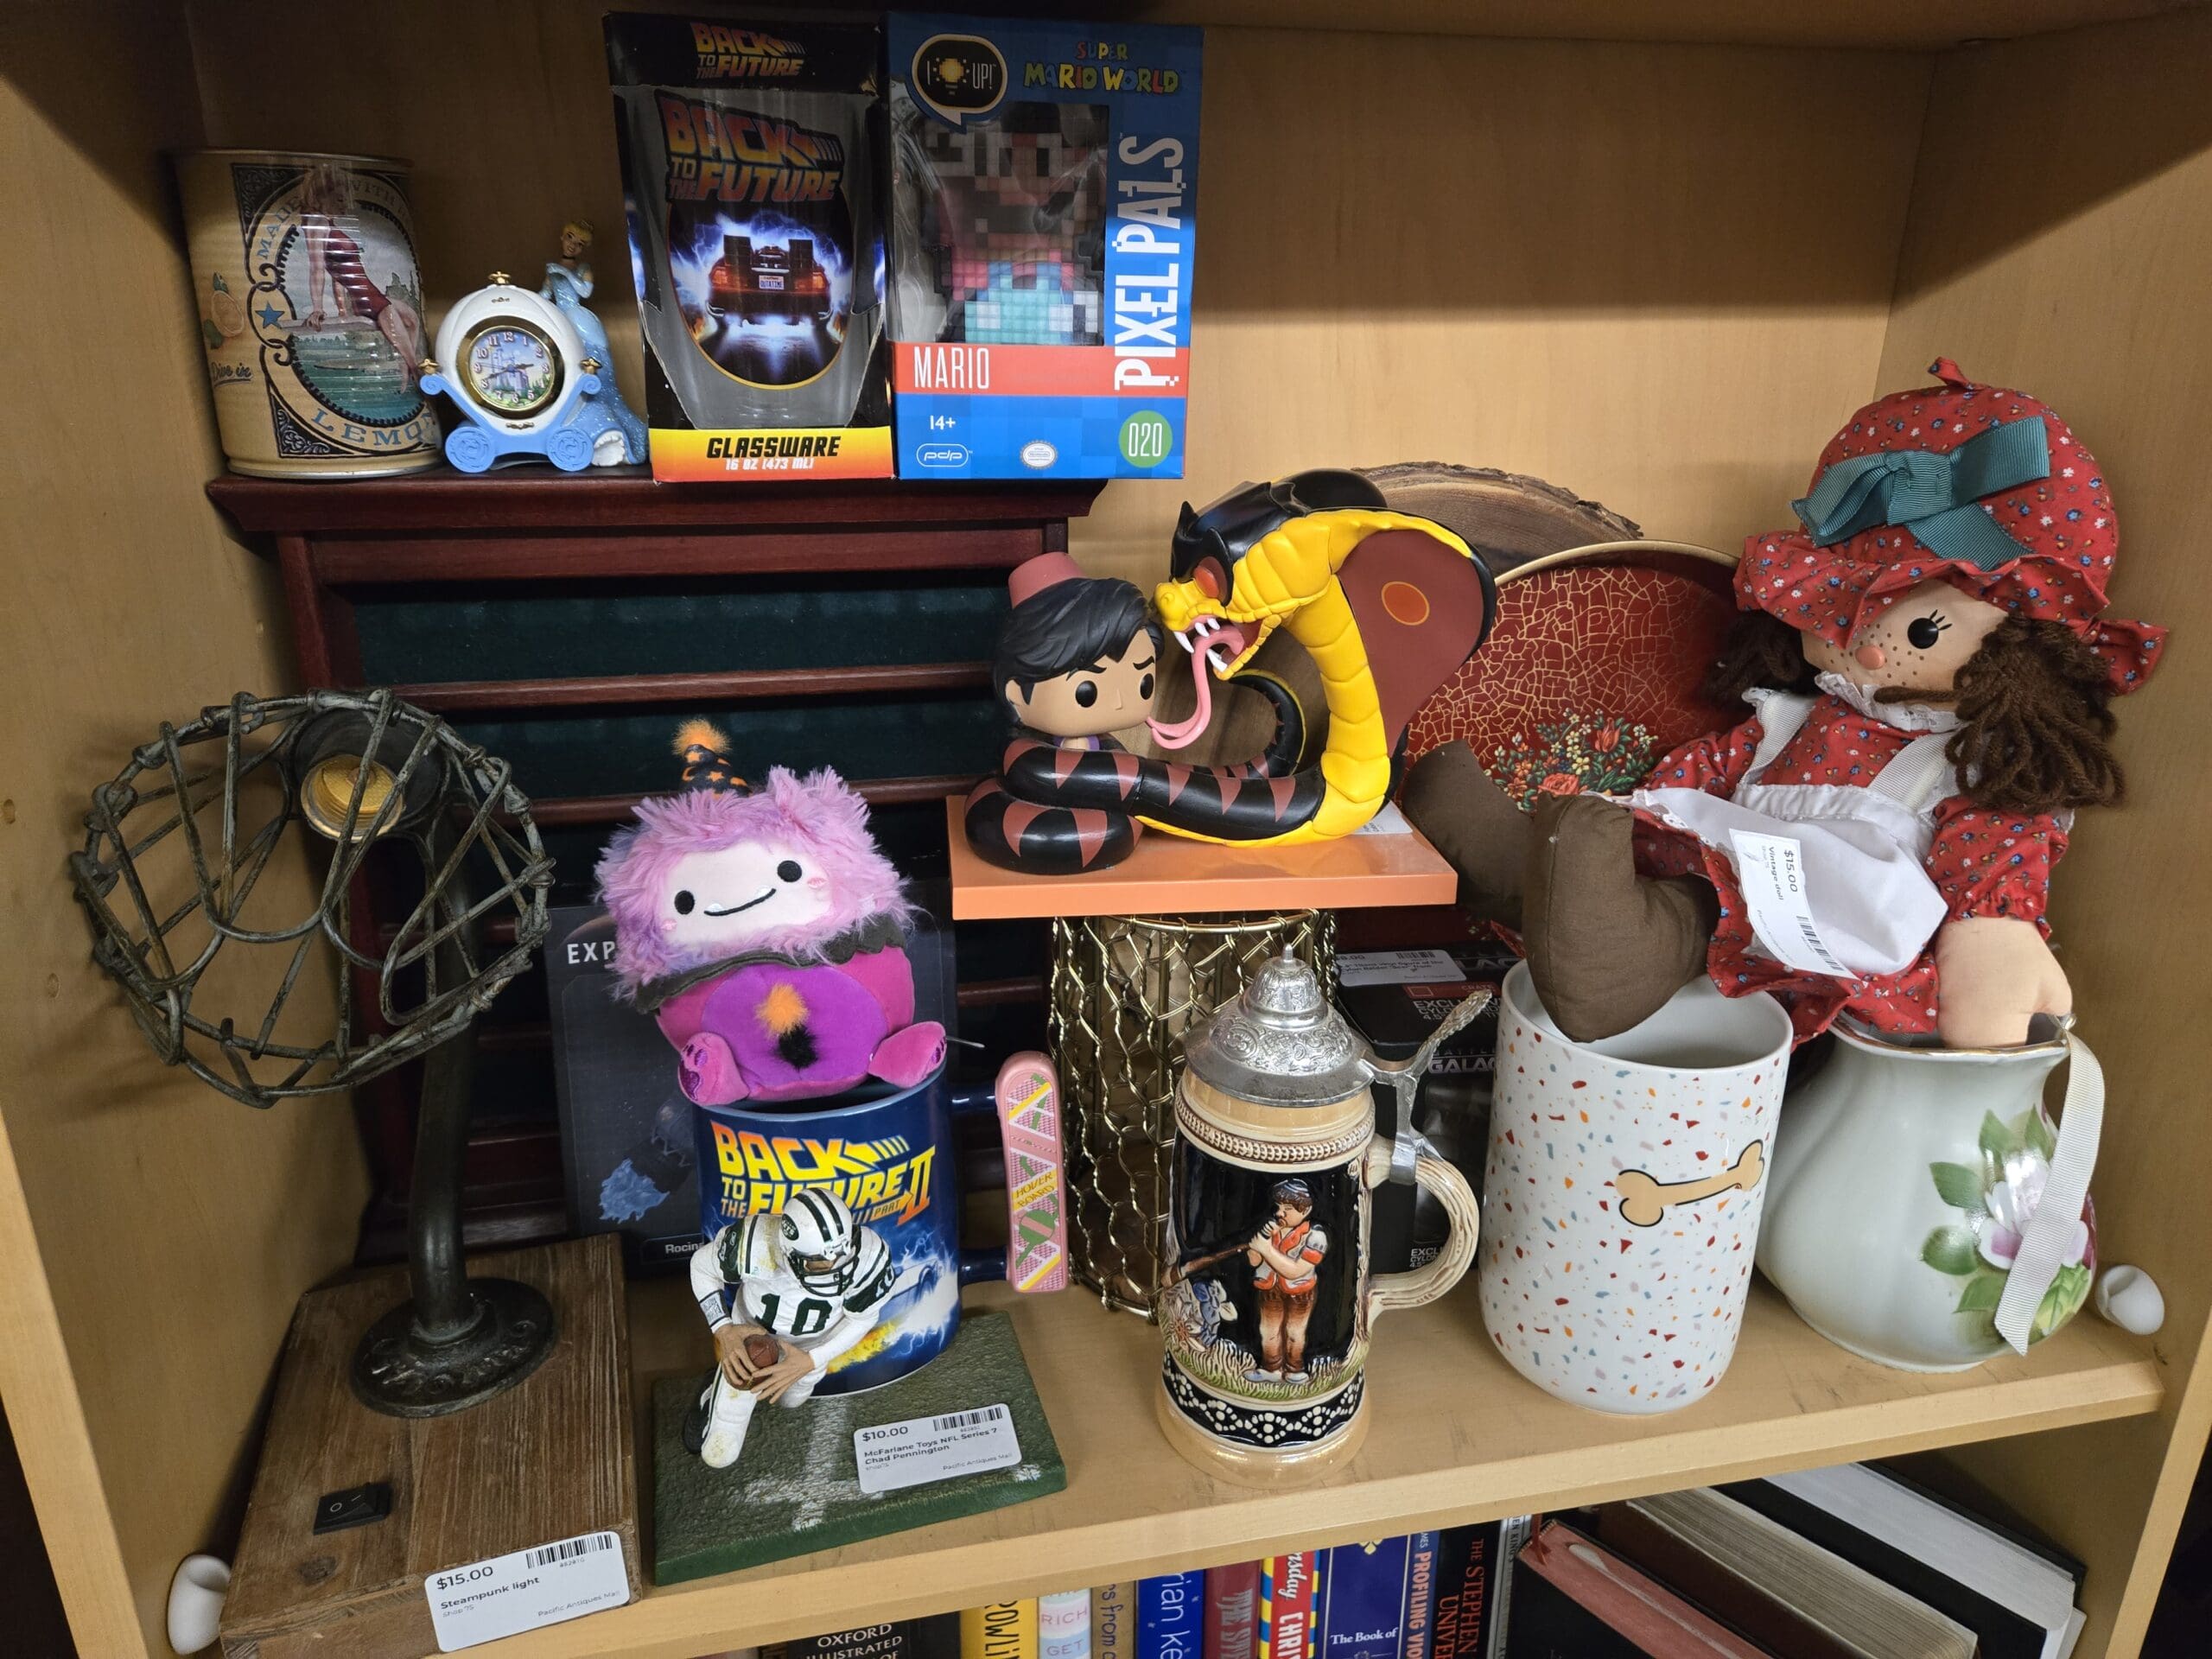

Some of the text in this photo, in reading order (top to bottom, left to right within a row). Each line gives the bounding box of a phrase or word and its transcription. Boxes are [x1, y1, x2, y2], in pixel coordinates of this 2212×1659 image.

[690, 22, 787, 56] BACK
[1076, 41, 1128, 60] SUPER
[698, 54, 804, 77] TO FUTURE
[1023, 62, 1180, 95] MARIO WORLD
[661, 96, 820, 168] BACK
[671, 157, 841, 202] TO FUTURE
[1112, 136, 1186, 391] PIXEL PALS
[488, 336, 499, 346] 11
[503, 332, 514, 342] 12
[477, 348, 488, 359] 10
[536, 347, 543, 358] 2
[474, 363, 481, 373] 9
[913, 346, 989, 390] MARIO
[495, 391, 502, 400] 7
[512, 394, 518, 404] 6
[528, 390, 534, 400] 5
[930, 415, 956, 430] 14+
[706, 436, 842, 458] GLASSWARE
[1128, 423, 1162, 457] 020
[725, 458, 739, 470] 16
[742, 458, 759, 469] OZ
[1769, 846, 1784, 901] Vintage doll
[1784, 849, 1797, 893] $15.00
[710, 1120, 882, 1181] BACK
[721, 1161, 908, 1215] TO FUURE
[721, 1198, 747, 1218] THE
[874, 1200, 900, 1218] PART
[755, 1294, 833, 1337] 10
[862, 1426, 908, 1442] $10.00
[864, 1444, 914, 1458] McFarlane
[916, 1439, 938, 1449] Toys
[940, 1435, 959, 1445] NFL
[961, 1429, 989, 1440] Series
[865, 1445, 950, 1465] Chad Pennington
[943, 1461, 965, 1471] Pacific
[967, 1456, 997, 1466] Antiques
[436, 1566, 494, 1591] $15.00
[441, 1576, 540, 1609] Steampunk light
[1408, 1551, 1432, 1630] PROFILING
[538, 1605, 564, 1618] Pacific
[566, 1595, 602, 1610] Antiques
[1458, 1567, 1484, 1653] STEPHEN
[817, 1624, 892, 1648] OXFORD
[1100, 1604, 1123, 1646] from
[1330, 1627, 1399, 1645] The Book of
[1046, 1638, 1085, 1656] GET
